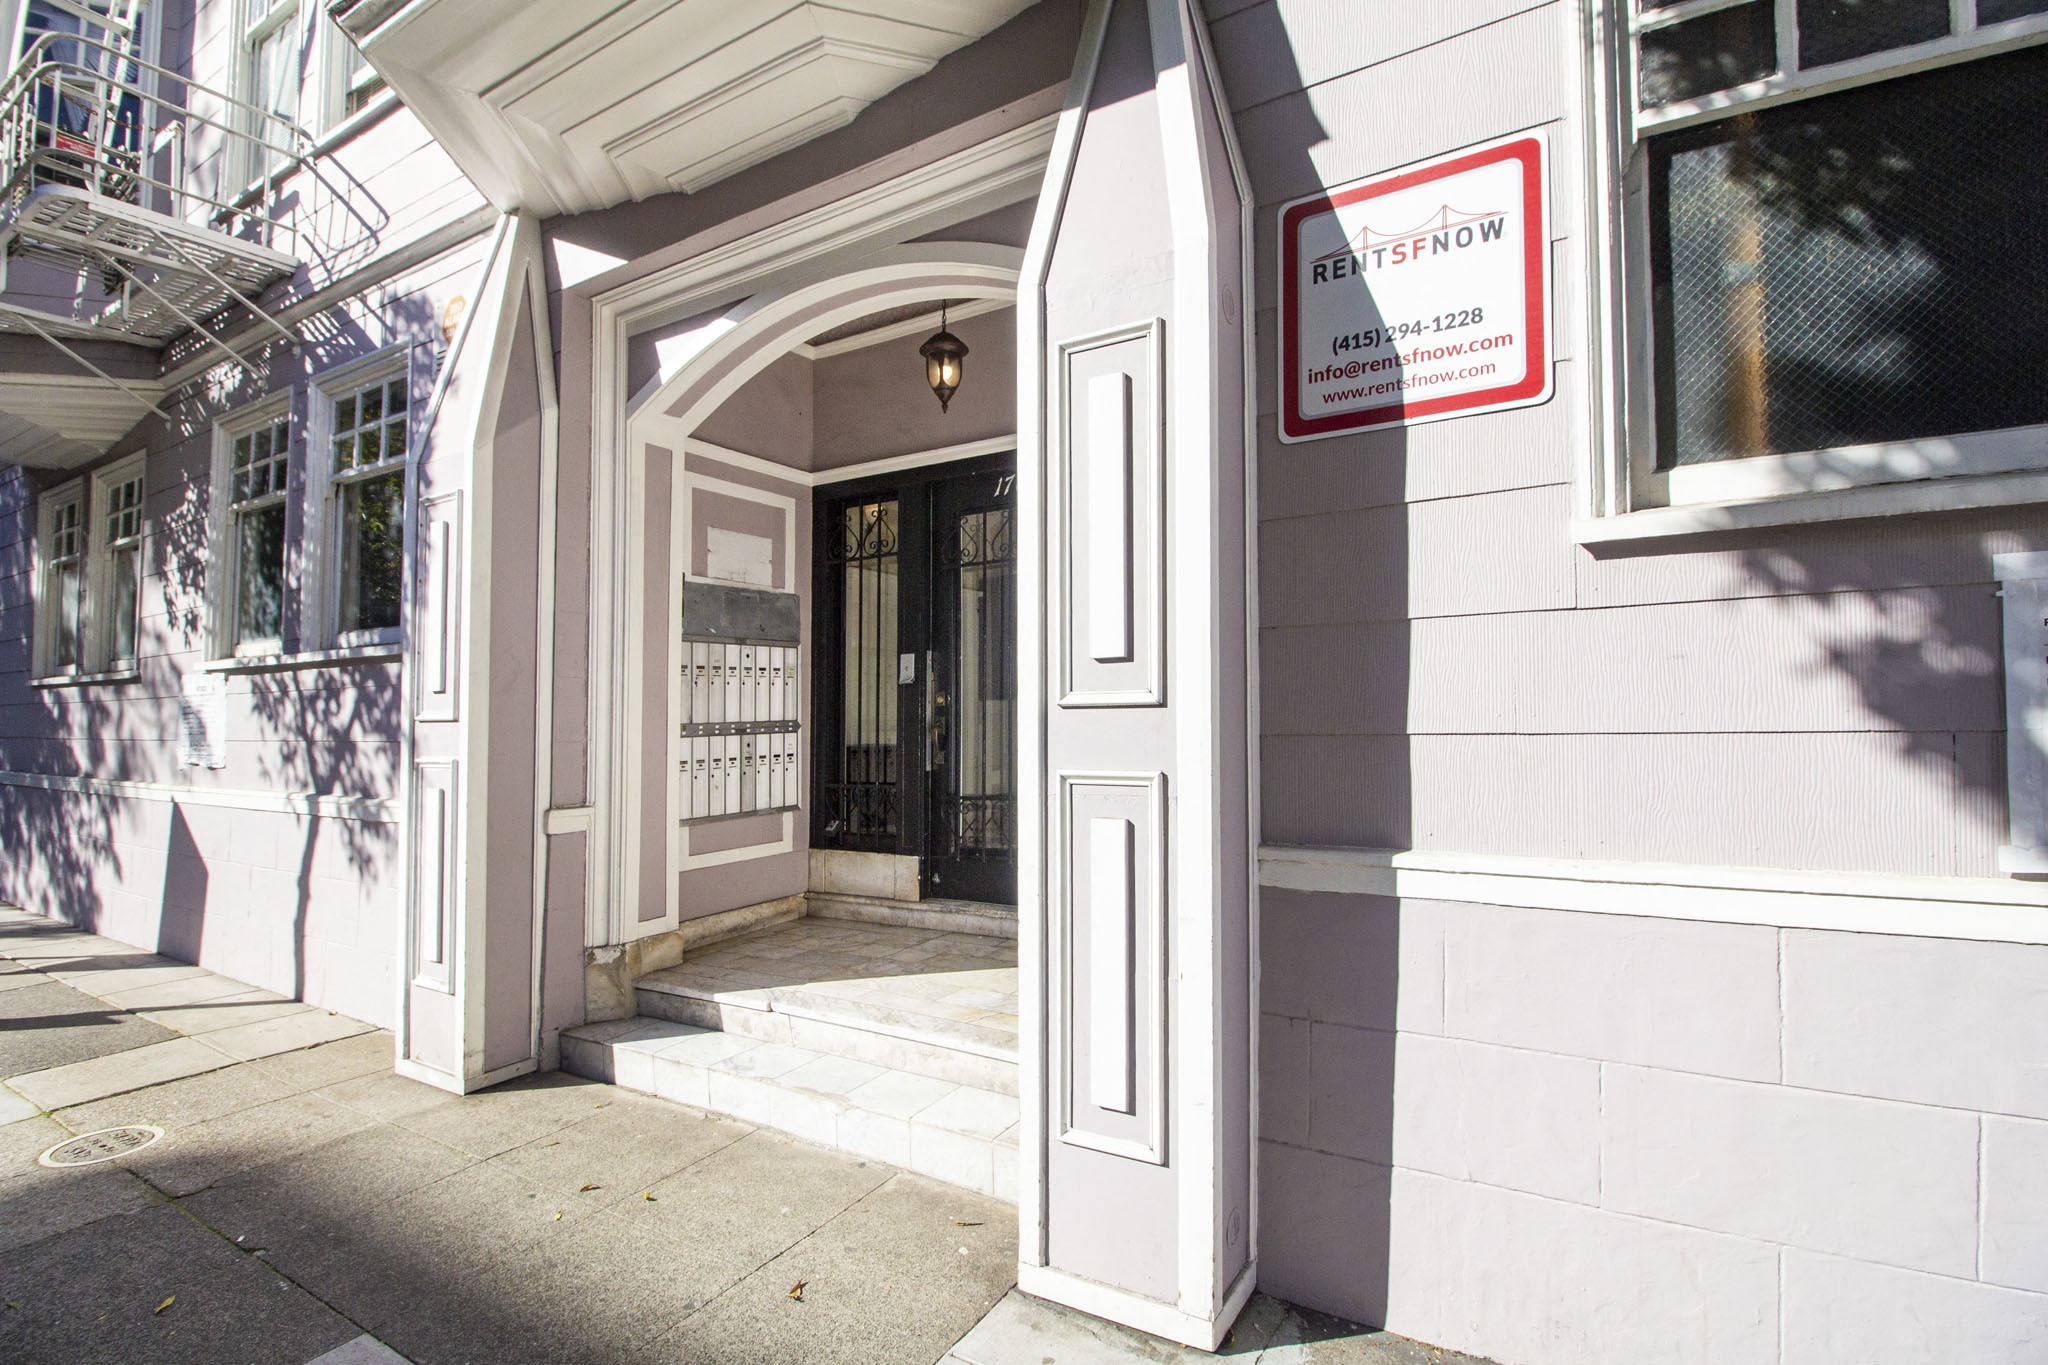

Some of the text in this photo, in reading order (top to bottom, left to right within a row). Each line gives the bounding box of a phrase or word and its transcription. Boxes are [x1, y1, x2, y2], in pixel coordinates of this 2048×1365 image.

[1313, 217, 1505, 285] RENTSFNOW
[1332, 307, 1484, 356] (415) 294-1228
[1308, 333, 1514, 384] info@rentsfnow.com
[1323, 363, 1497, 404] www.rentsfnow.com
